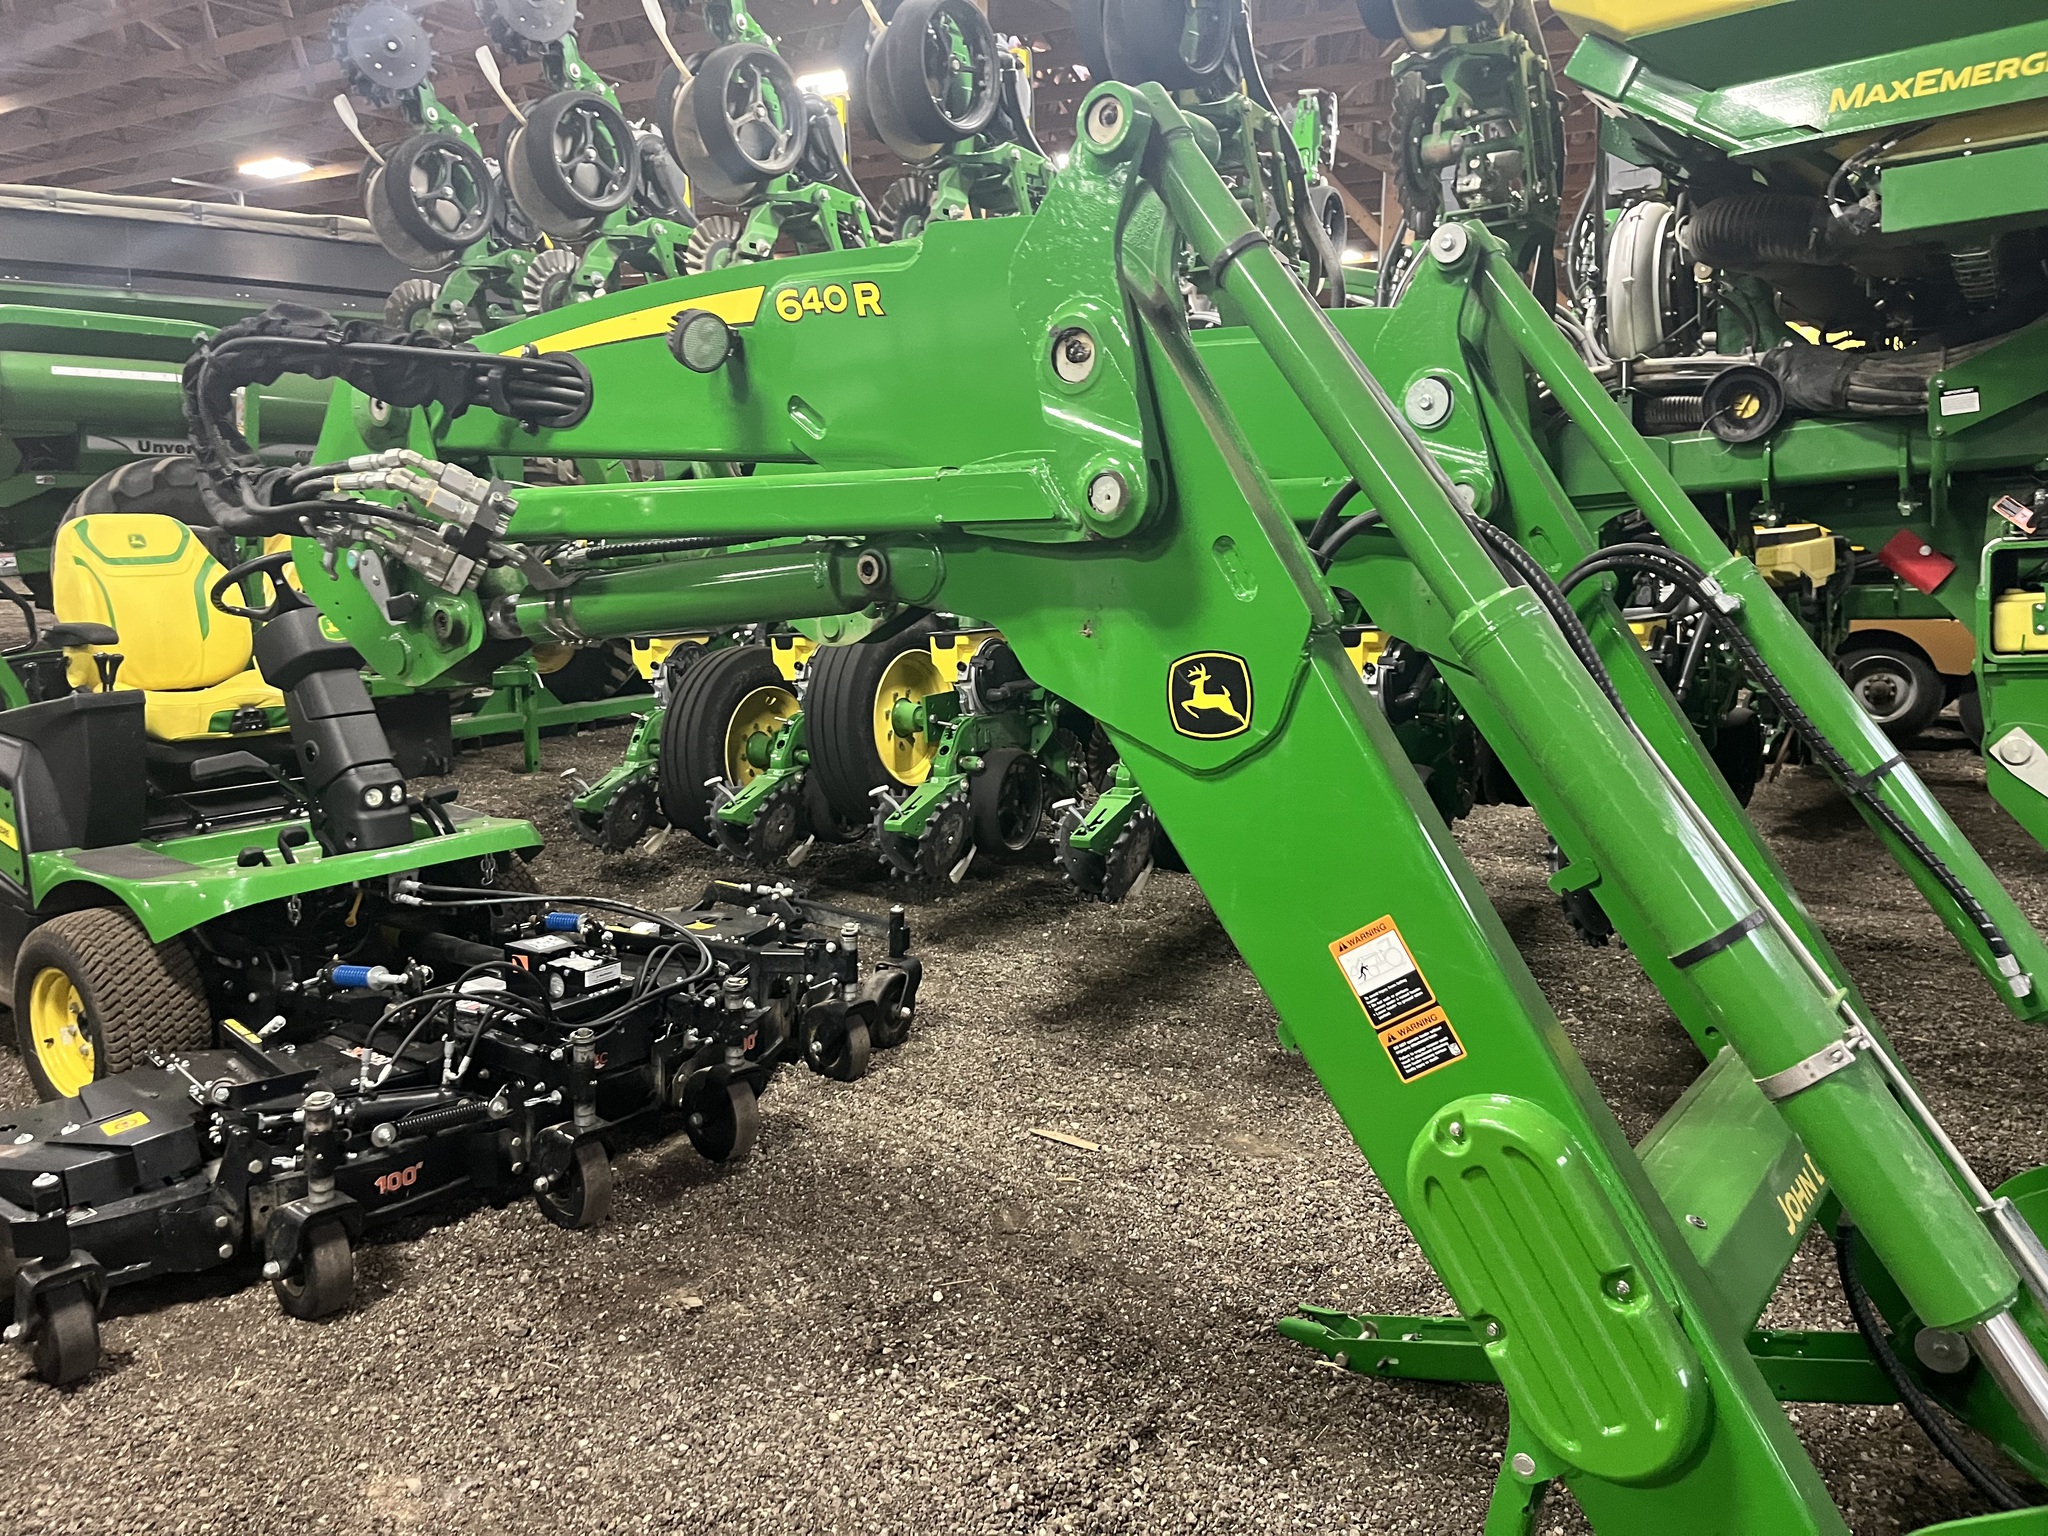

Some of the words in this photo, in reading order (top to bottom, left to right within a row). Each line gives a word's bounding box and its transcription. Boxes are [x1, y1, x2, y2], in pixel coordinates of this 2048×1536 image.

[1828, 51, 2048, 113] MAXEMERG
[1346, 922, 1387, 947] WARNING
[1396, 1013, 1438, 1037] WARNING
[1776, 1166, 1819, 1236] JOHN
